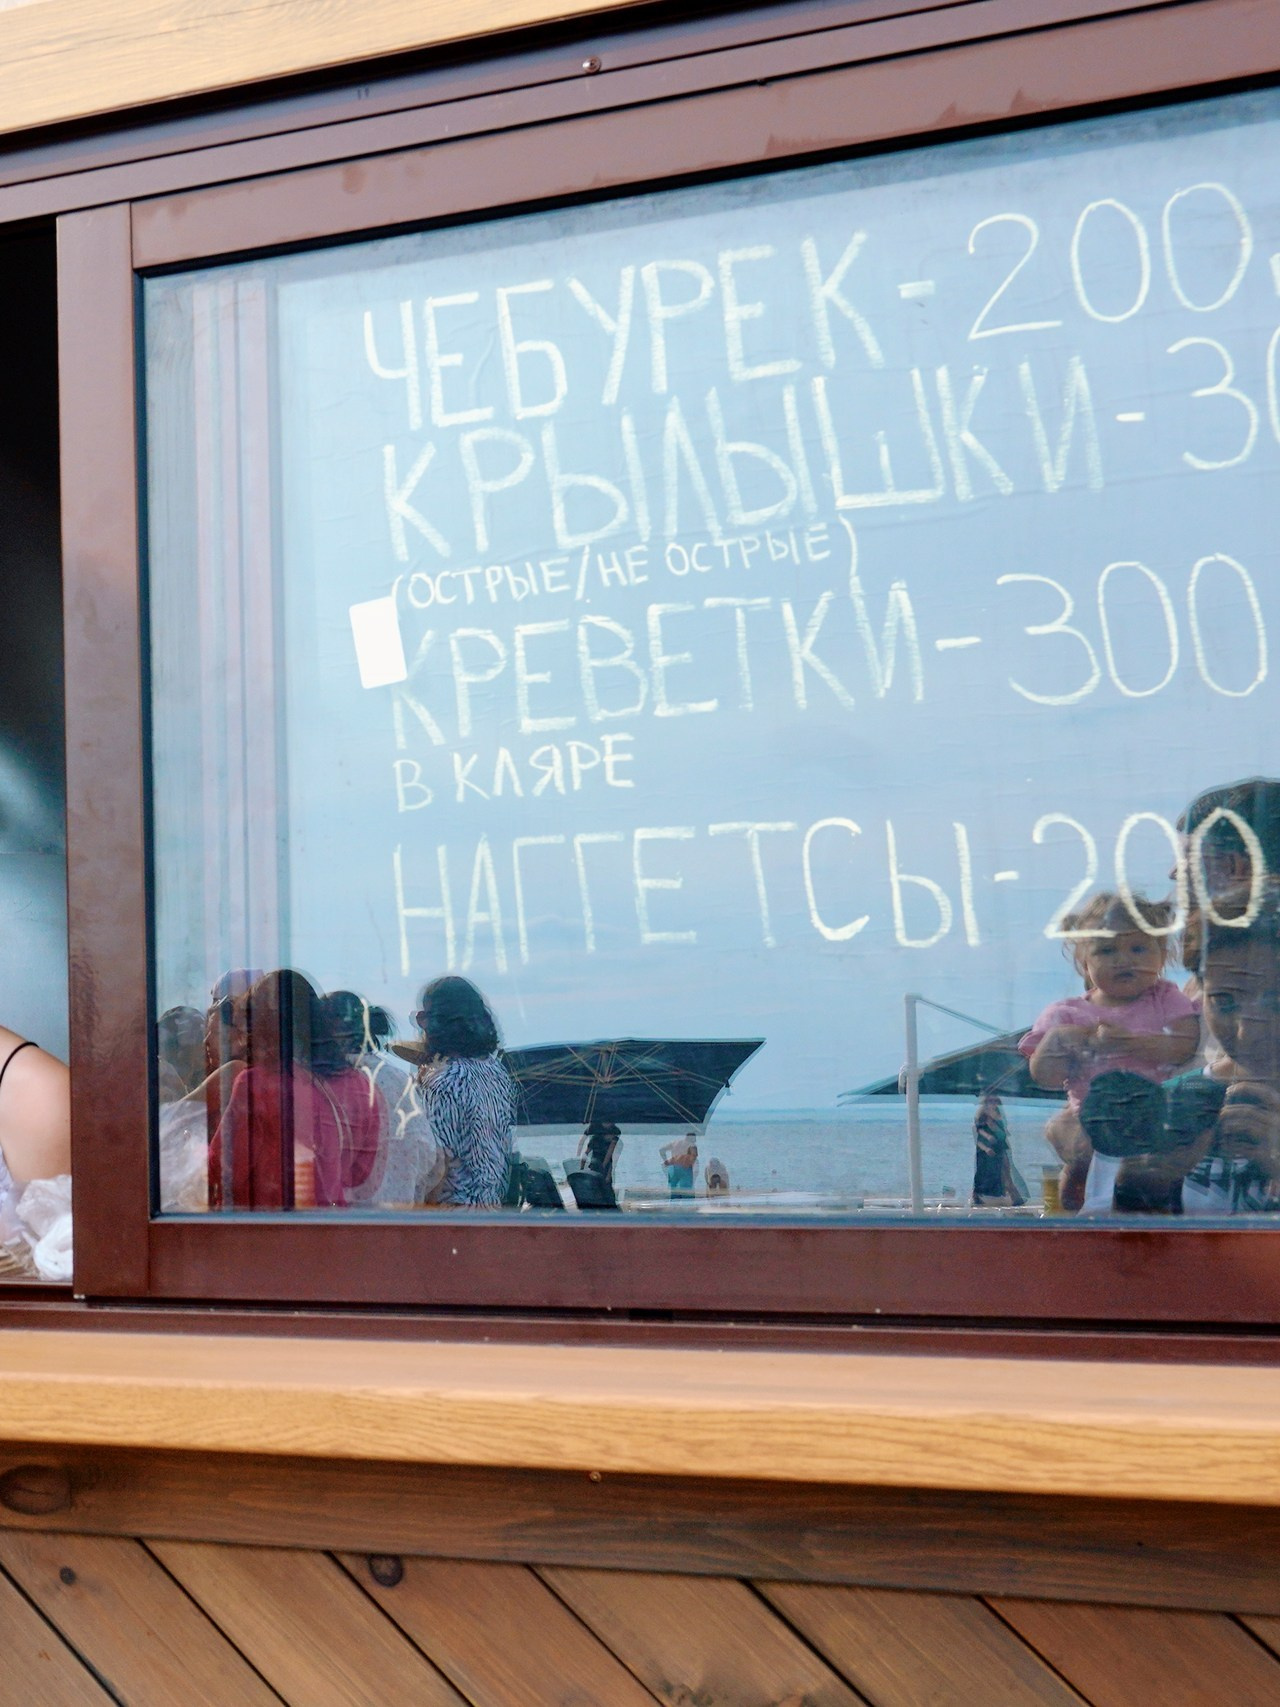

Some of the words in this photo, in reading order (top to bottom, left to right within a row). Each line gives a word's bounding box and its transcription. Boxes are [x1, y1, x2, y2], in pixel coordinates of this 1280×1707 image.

[363, 229, 885, 430] ЧЕБУРЕК
[382, 354, 1106, 562] КРЫЛЫШКИ
[1166, 325, 1280, 470] 3
[391, 574, 924, 750] КРЕВЕТКИ
[995, 552, 1270, 706] 300
[393, 758, 435, 814] В
[452, 733, 636, 804] КЛЯРЕ
[393, 816, 981, 977] НАГГЕТСЫ
[1033, 806, 1266, 940] 200
